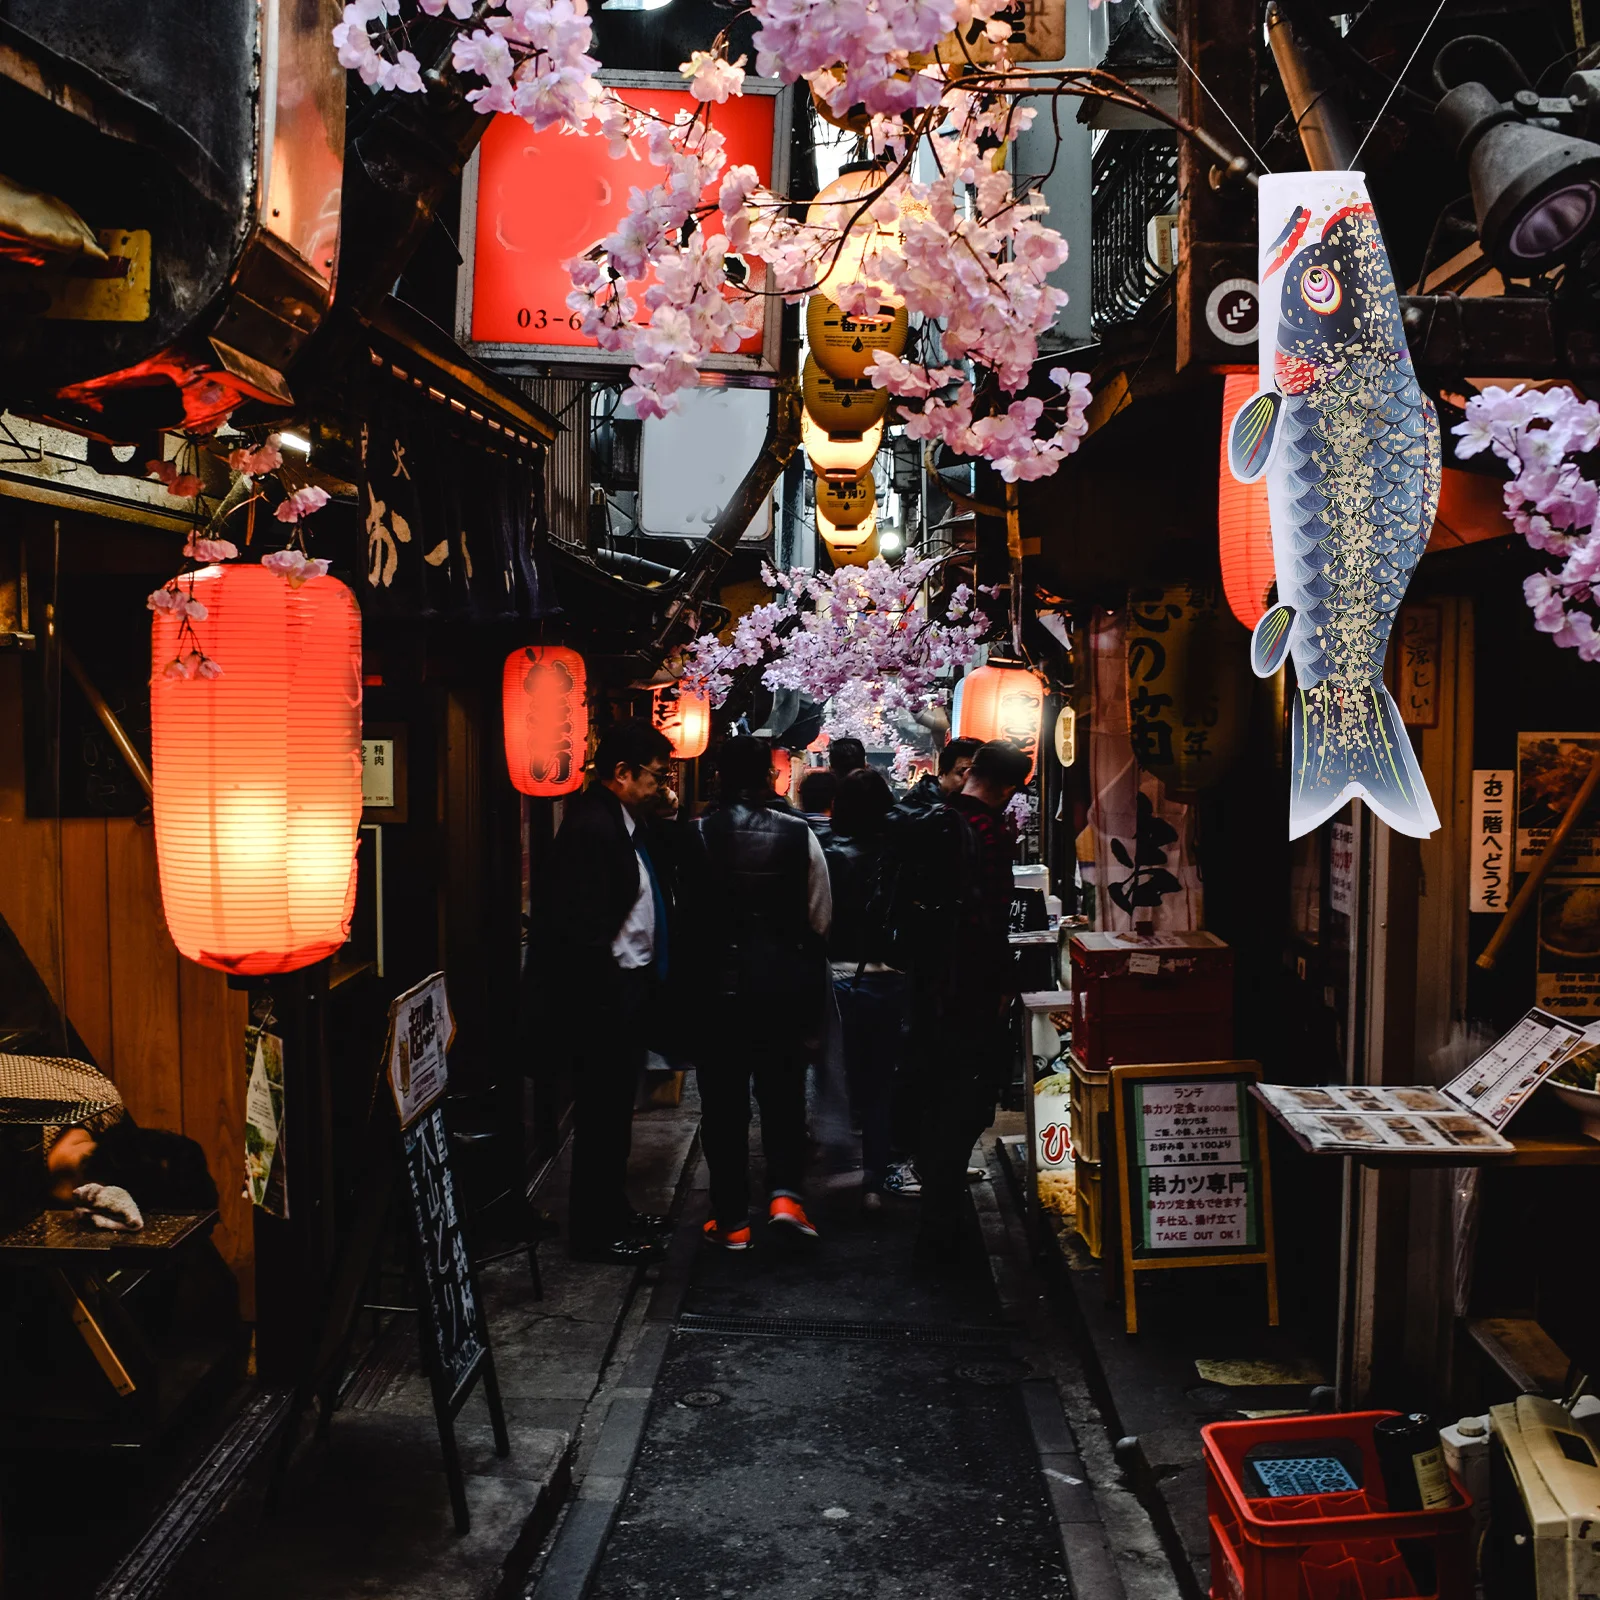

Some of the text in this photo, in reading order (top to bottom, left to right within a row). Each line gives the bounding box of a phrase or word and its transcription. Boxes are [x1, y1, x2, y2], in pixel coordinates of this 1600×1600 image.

[1174, 1087, 1204, 1099] ランチ
[1148, 1172, 1248, 1196] 串カツ専門
[1156, 1231, 1187, 1241] TAKE
[1194, 1231, 1214, 1240] OUT
